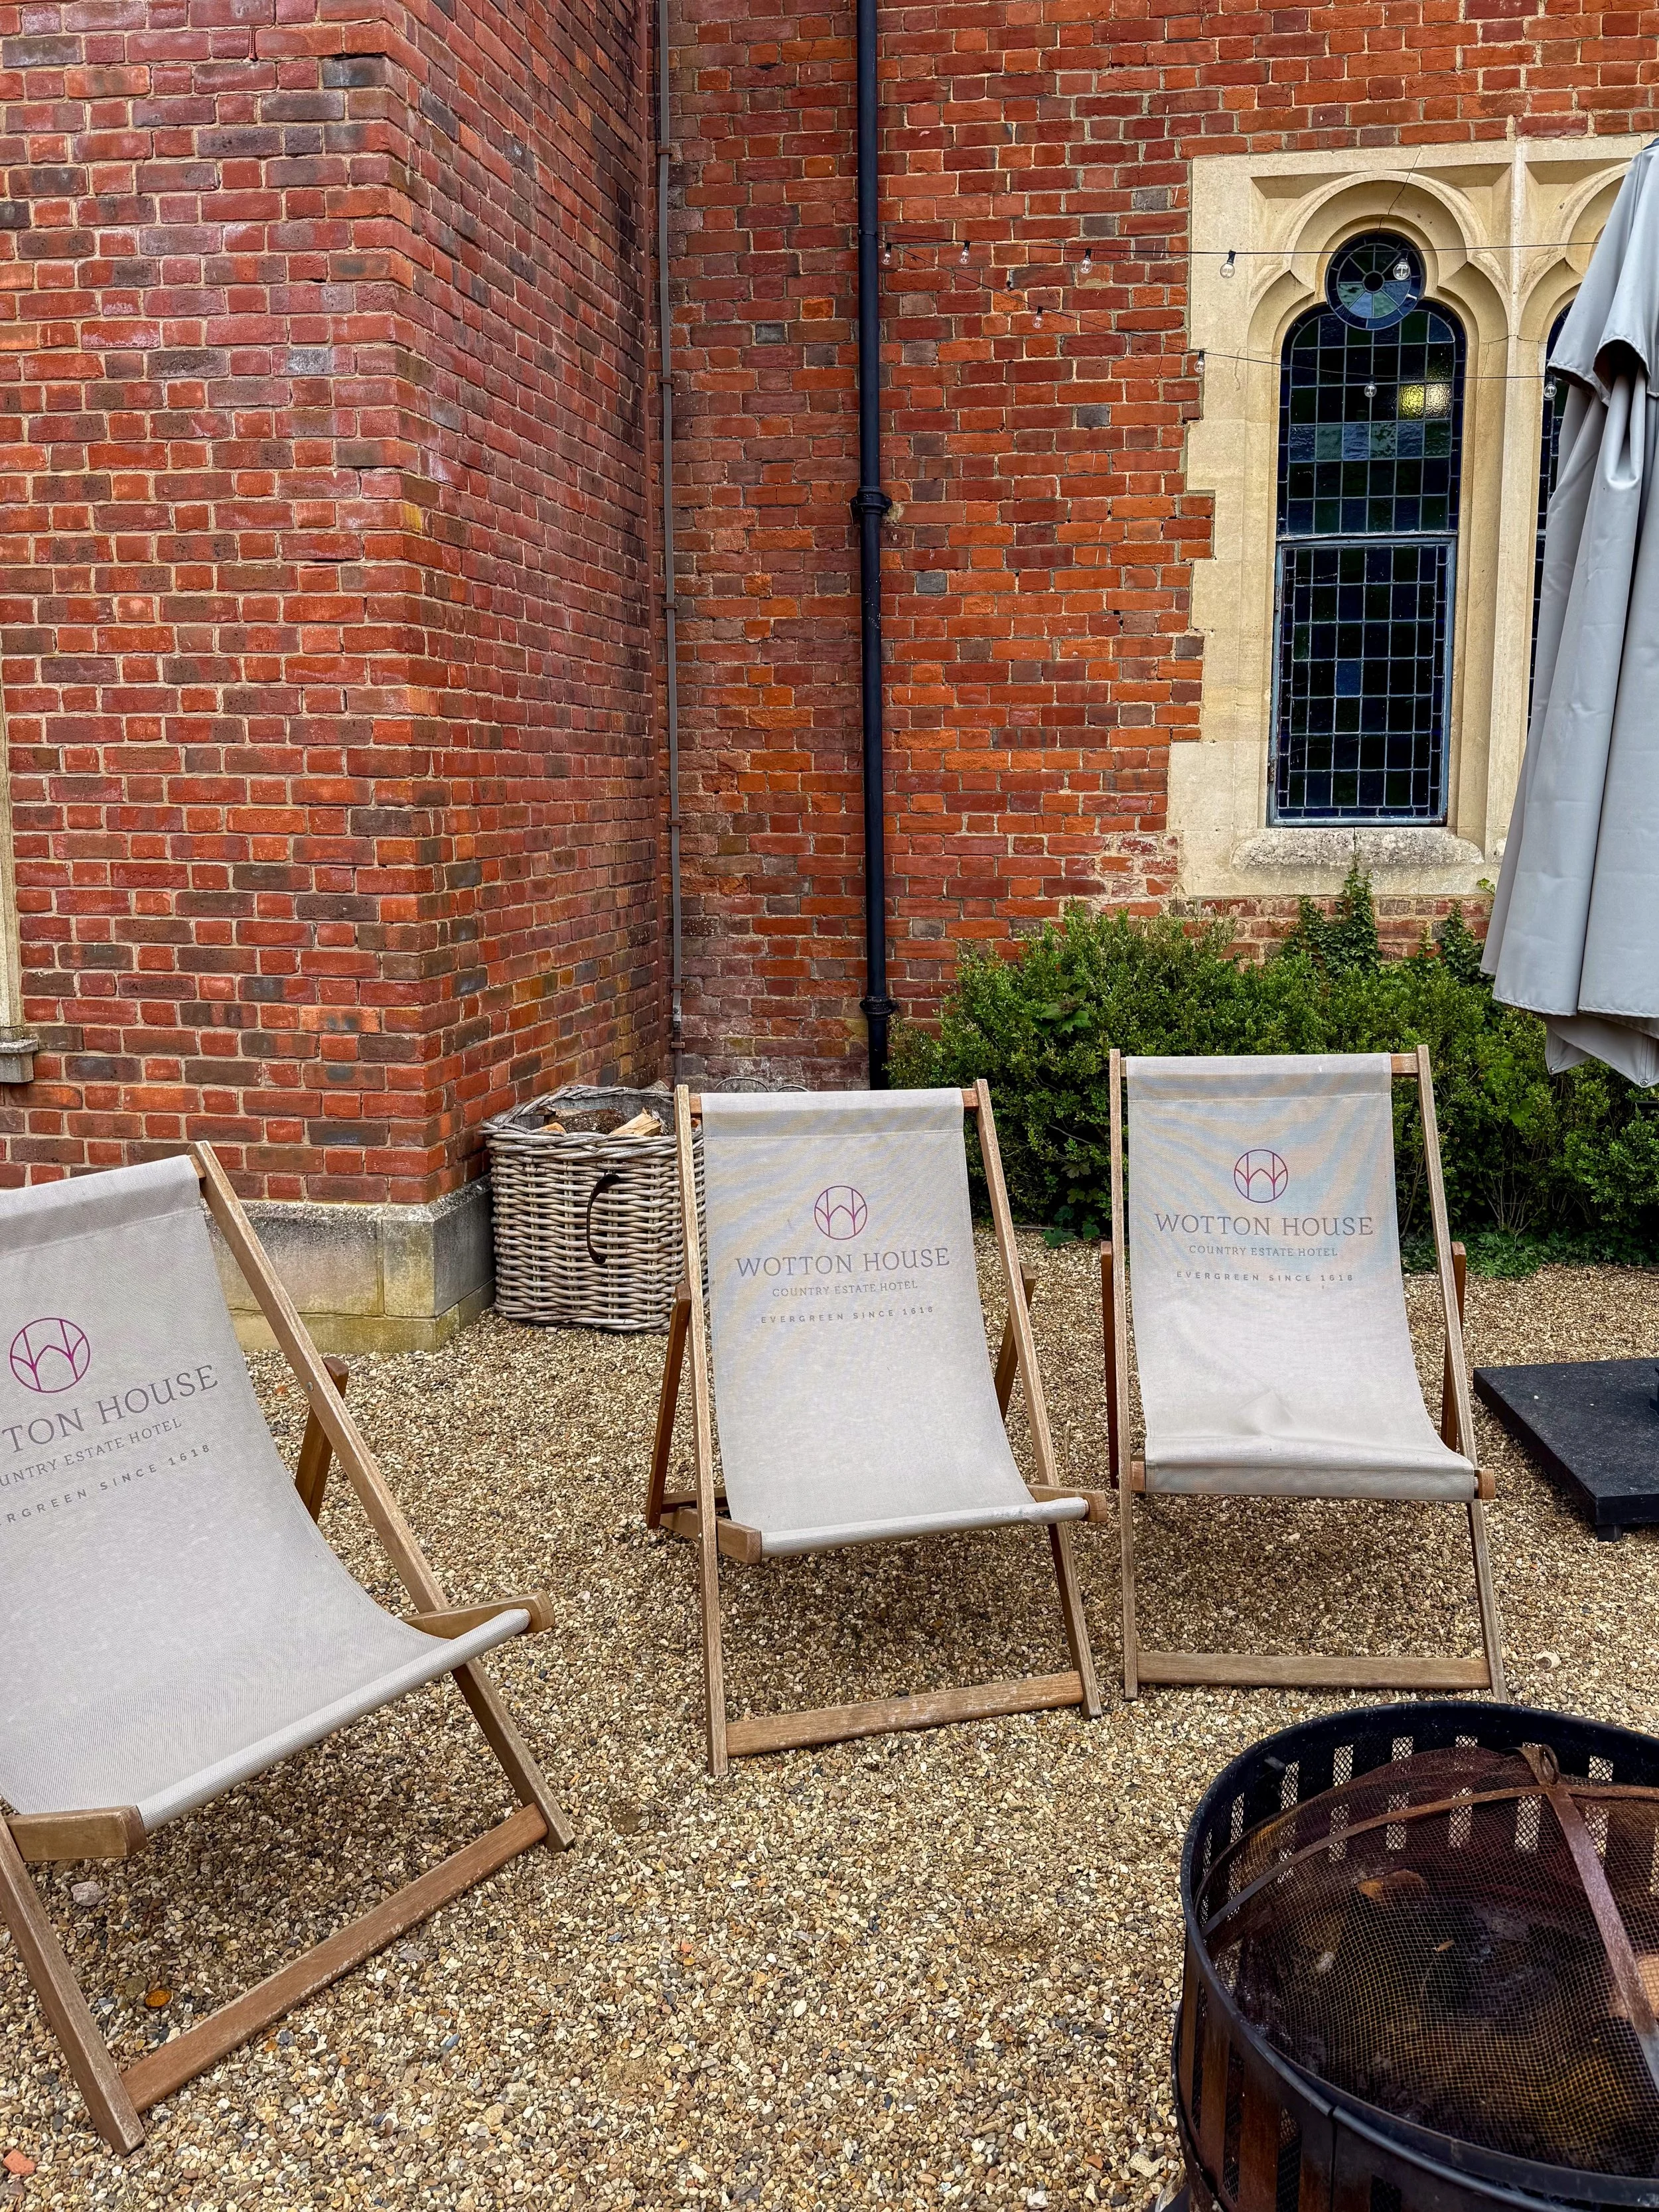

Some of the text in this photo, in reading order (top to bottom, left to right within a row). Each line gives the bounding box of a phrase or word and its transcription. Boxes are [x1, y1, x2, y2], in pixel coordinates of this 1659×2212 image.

[1154, 1213, 1374, 1237] WOTTON HOUSE
[735, 1247, 950, 1277] WOTTON HOUSE
[1189, 1245, 1338, 1257] COUNTRY ESTATE HOTEL
[1177, 1271, 1259, 1281] EVERGREEN
[772, 1280, 918, 1297] COUNTRY ESTATE HOTEL
[761, 1306, 934, 1324] EVERGREEN SINCE 1618
[1, 1365, 218, 1453] TON HOUSE
[0, 1417, 182, 1486] UNTRY ESTATE HOTEL
[0, 1444, 210, 1525] RGREEN SINCE 1618
